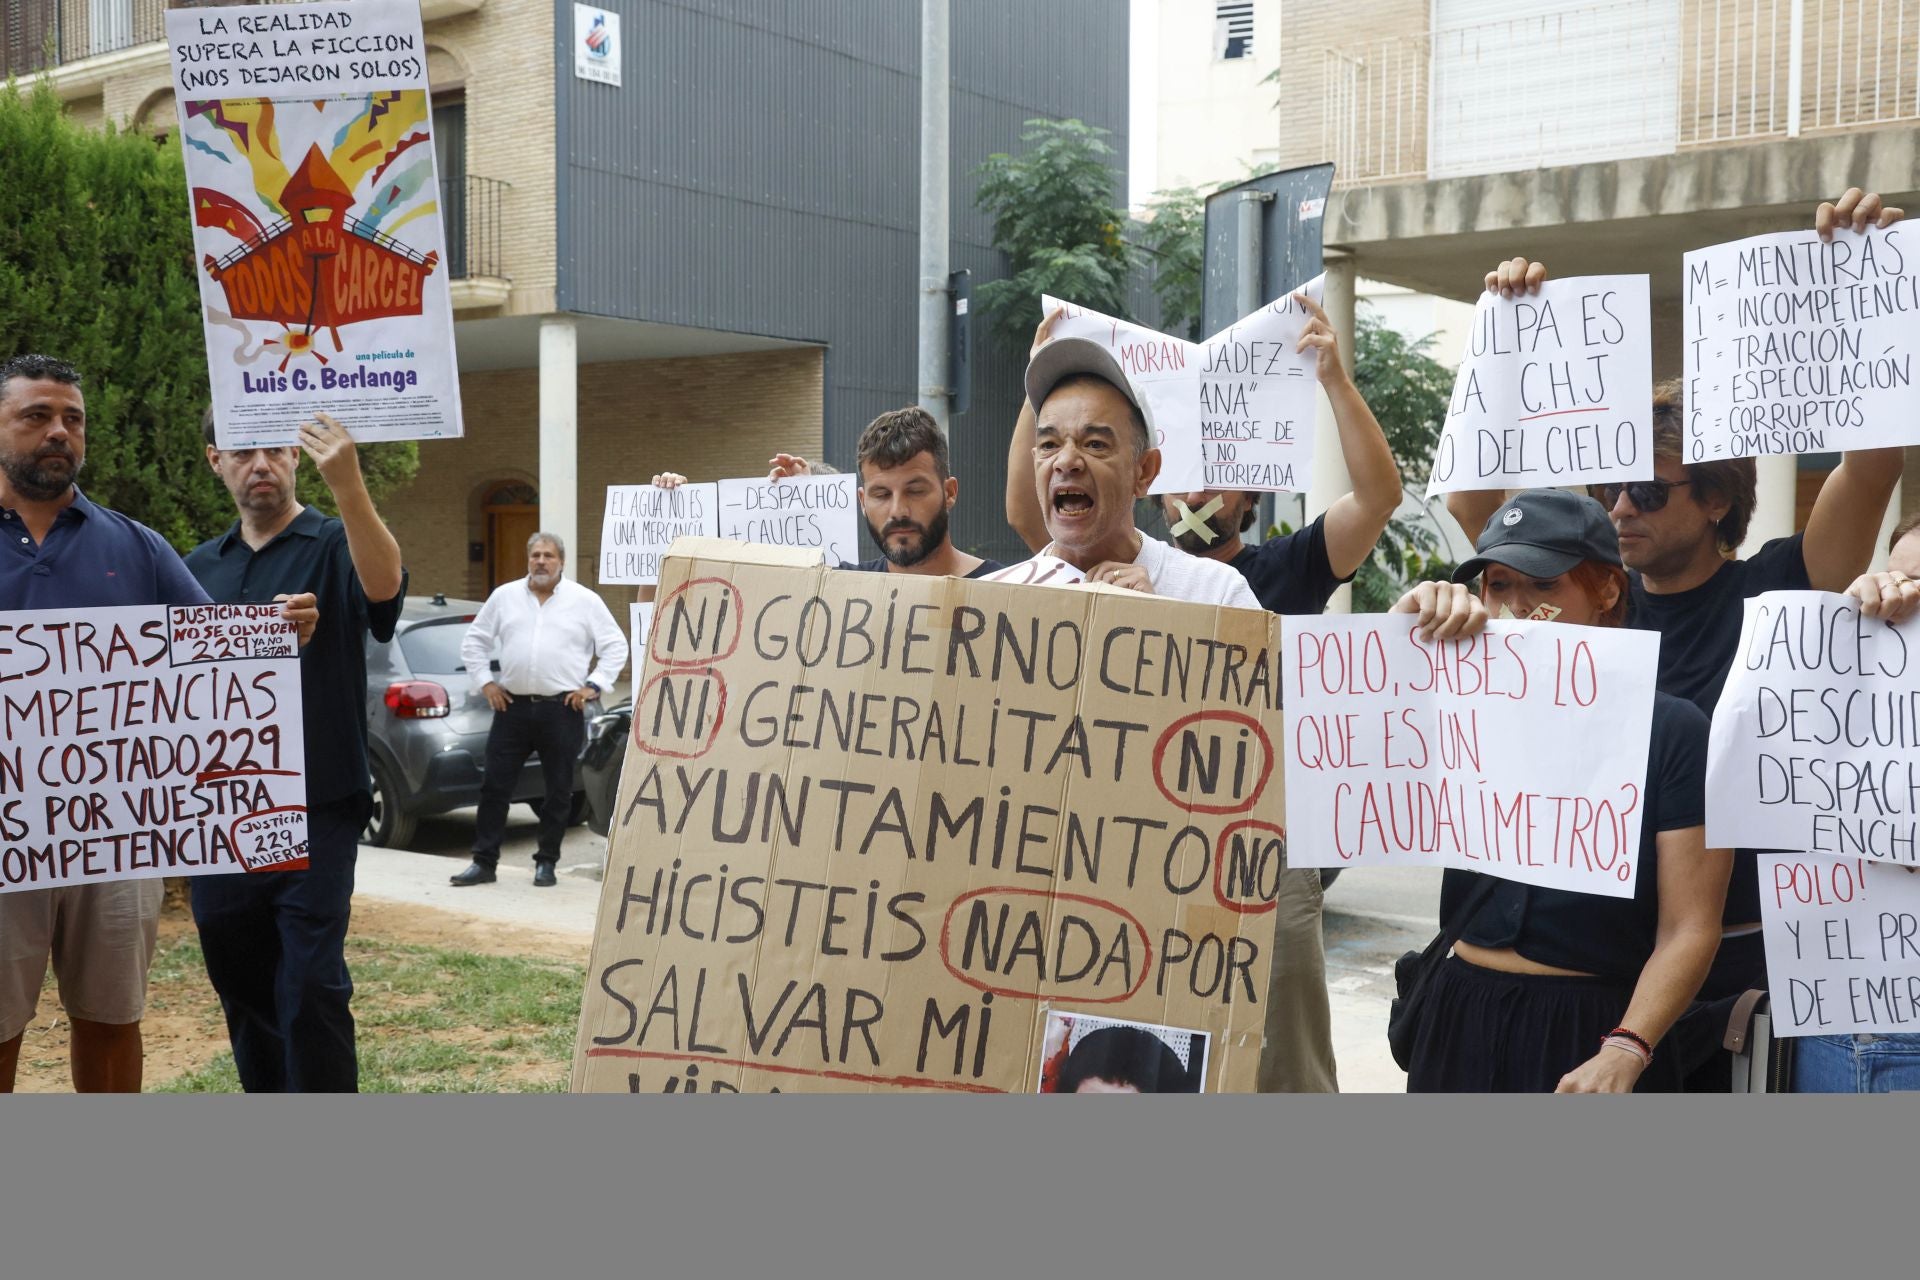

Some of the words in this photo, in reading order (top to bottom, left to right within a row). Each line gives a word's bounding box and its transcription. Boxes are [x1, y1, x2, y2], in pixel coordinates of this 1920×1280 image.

[200, 17, 228, 35] LA
[238, 12, 352, 34] REALIDAD
[177, 42, 263, 63] SUPERA
[274, 40, 301, 57] LA
[312, 34, 415, 56] FICCION
[180, 67, 229, 91] (NOS
[243, 63, 340, 85] DEJARON
[350, 56, 422, 81] SOLOS)
[302, 229, 313, 249] A
[315, 227, 335, 248] LA
[222, 236, 313, 317] TODOS
[333, 238, 419, 315] CARCEL
[1737, 231, 1904, 289] MENTIRAS
[1463, 300, 1562, 362] ULPA
[1582, 292, 1624, 346] ES
[1732, 323, 1862, 369] TRAICIÓN
[405, 349, 415, 358] de
[1733, 345, 1911, 403] ESPECULACIÓN
[243, 370, 287, 394] Luis
[291, 368, 316, 391] G.
[320, 365, 417, 393] Berlanga
[1275, 421, 1294, 441] DE
[1729, 396, 1864, 434] CORRUPTOS
[1217, 443, 1236, 461] NO
[1478, 429, 1538, 477] DEL
[1546, 421, 1636, 474] CIELO
[611, 491, 625, 516] EL
[630, 490, 662, 518] AGUA
[669, 491, 685, 519] NO
[690, 489, 703, 518] ES
[746, 480, 849, 511] DESPACHOS
[614, 520, 637, 545] UNA
[747, 514, 822, 546] CAUCES
[606, 552, 622, 578] EL
[245, 605, 279, 620] QUE
[173, 627, 200, 643] NO
[204, 625, 225, 639] SE
[192, 637, 249, 661] 229
[252, 638, 265, 648] YA
[268, 637, 283, 646] NO
[255, 645, 291, 657] ESTAN
[1746, 604, 1907, 678] CAUCES
[1409, 625, 1528, 700] SABES
[1554, 638, 1597, 707] LO
[38, 734, 201, 787] COSTADO
[204, 723, 281, 772] 229
[1297, 714, 1368, 771] QUE
[1384, 708, 1428, 770] ES
[1439, 708, 1480, 773] UN
[46, 792, 114, 835] POR
[122, 778, 276, 827] VUESTRA
[255, 830, 293, 853] 229
[1334, 777, 1638, 882] CAUDALÍMETRO?
[0, 819, 237, 888] OMPETENCIA
[1226, 833, 1284, 901] NO
[1774, 858, 1866, 909] POLO!
[962, 898, 1132, 993] NADA
[1157, 928, 1258, 1004] POR
[1785, 920, 1801, 960] Y
[1824, 918, 1865, 960] EL
[1879, 912, 1920, 962] PR
[592, 958, 884, 1067] SALVAR
[1788, 977, 1832, 1027] DE
